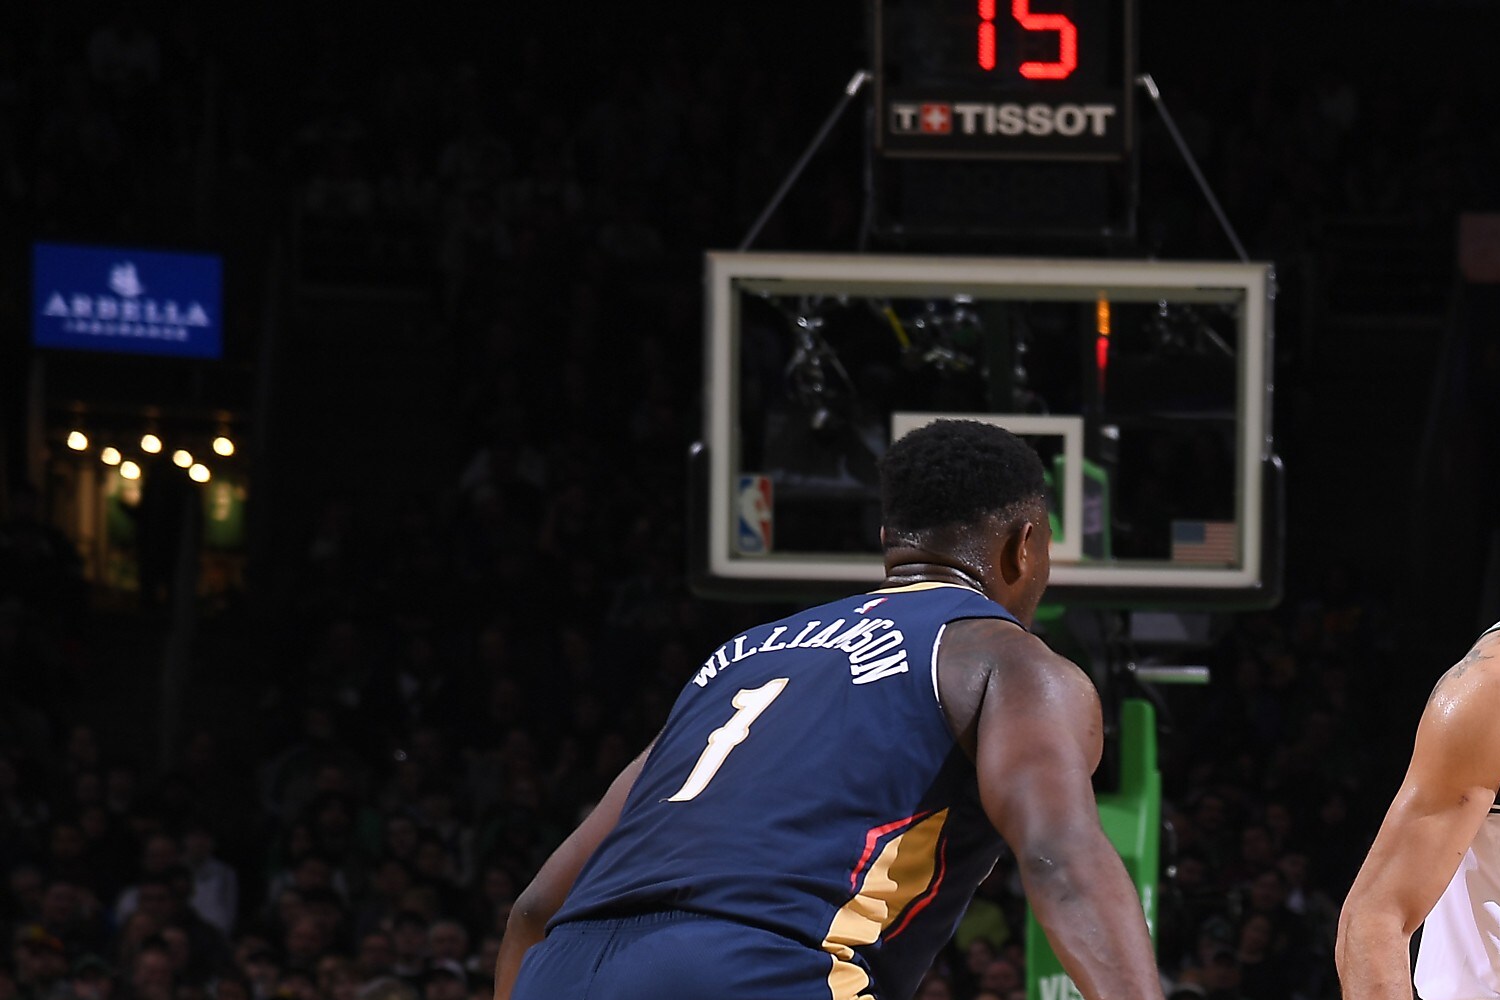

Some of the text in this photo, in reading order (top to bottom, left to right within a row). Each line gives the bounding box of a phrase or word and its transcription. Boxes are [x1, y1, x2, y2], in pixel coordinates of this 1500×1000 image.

[978, 0, 1077, 79] 15
[954, 105, 1115, 136] TISSOT
[659, 677, 790, 802] 1
